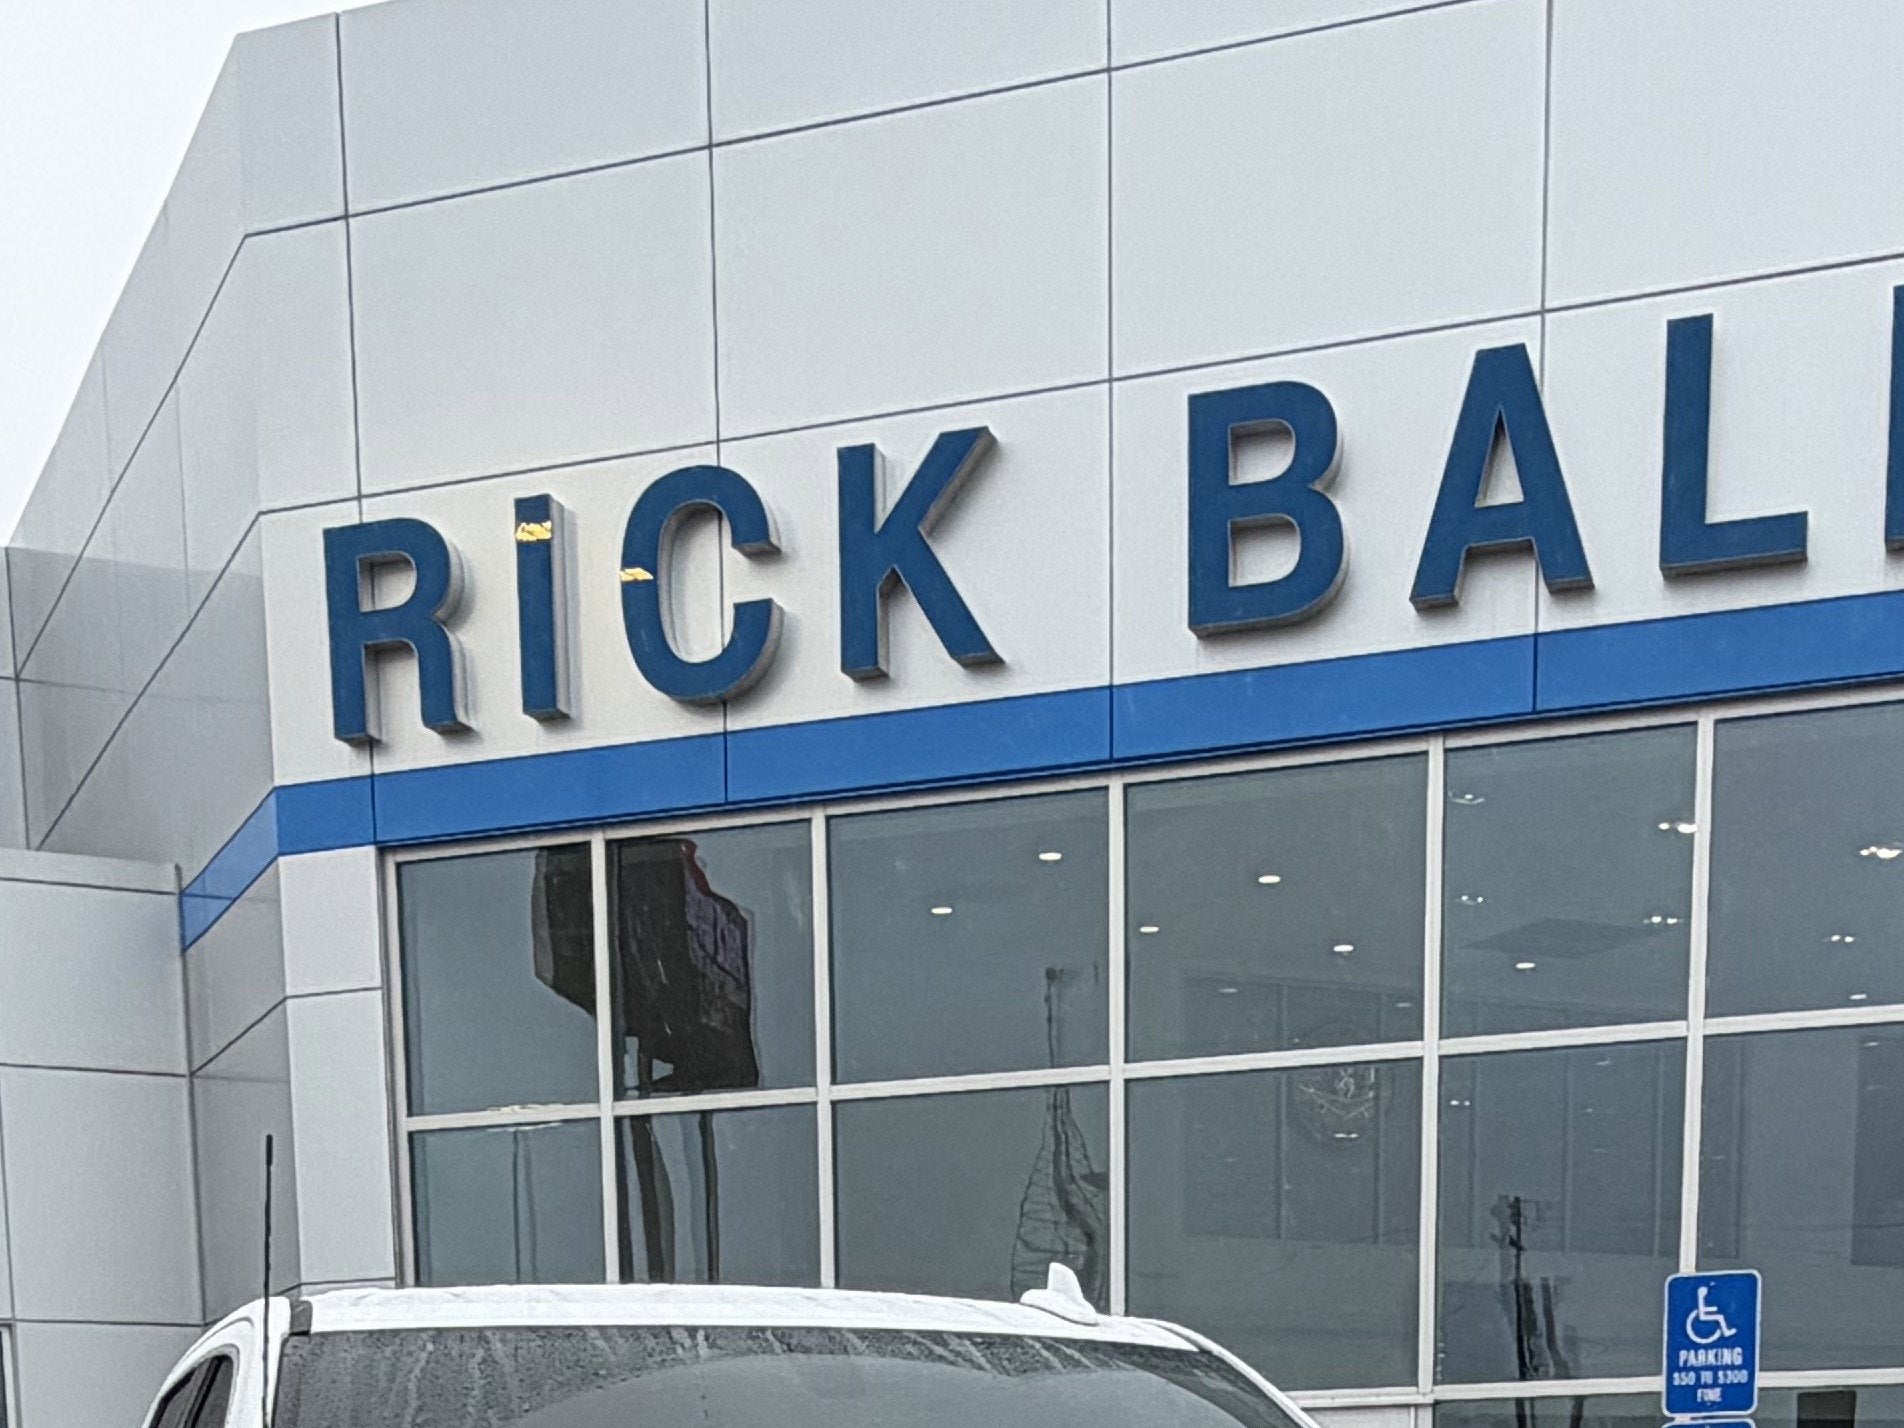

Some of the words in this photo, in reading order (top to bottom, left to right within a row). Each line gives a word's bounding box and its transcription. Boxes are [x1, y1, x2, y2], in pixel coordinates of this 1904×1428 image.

[322, 426, 1002, 746] RICK
[1678, 1347, 1743, 1367] PARKING
[1700, 1370, 1713, 1386] TO
